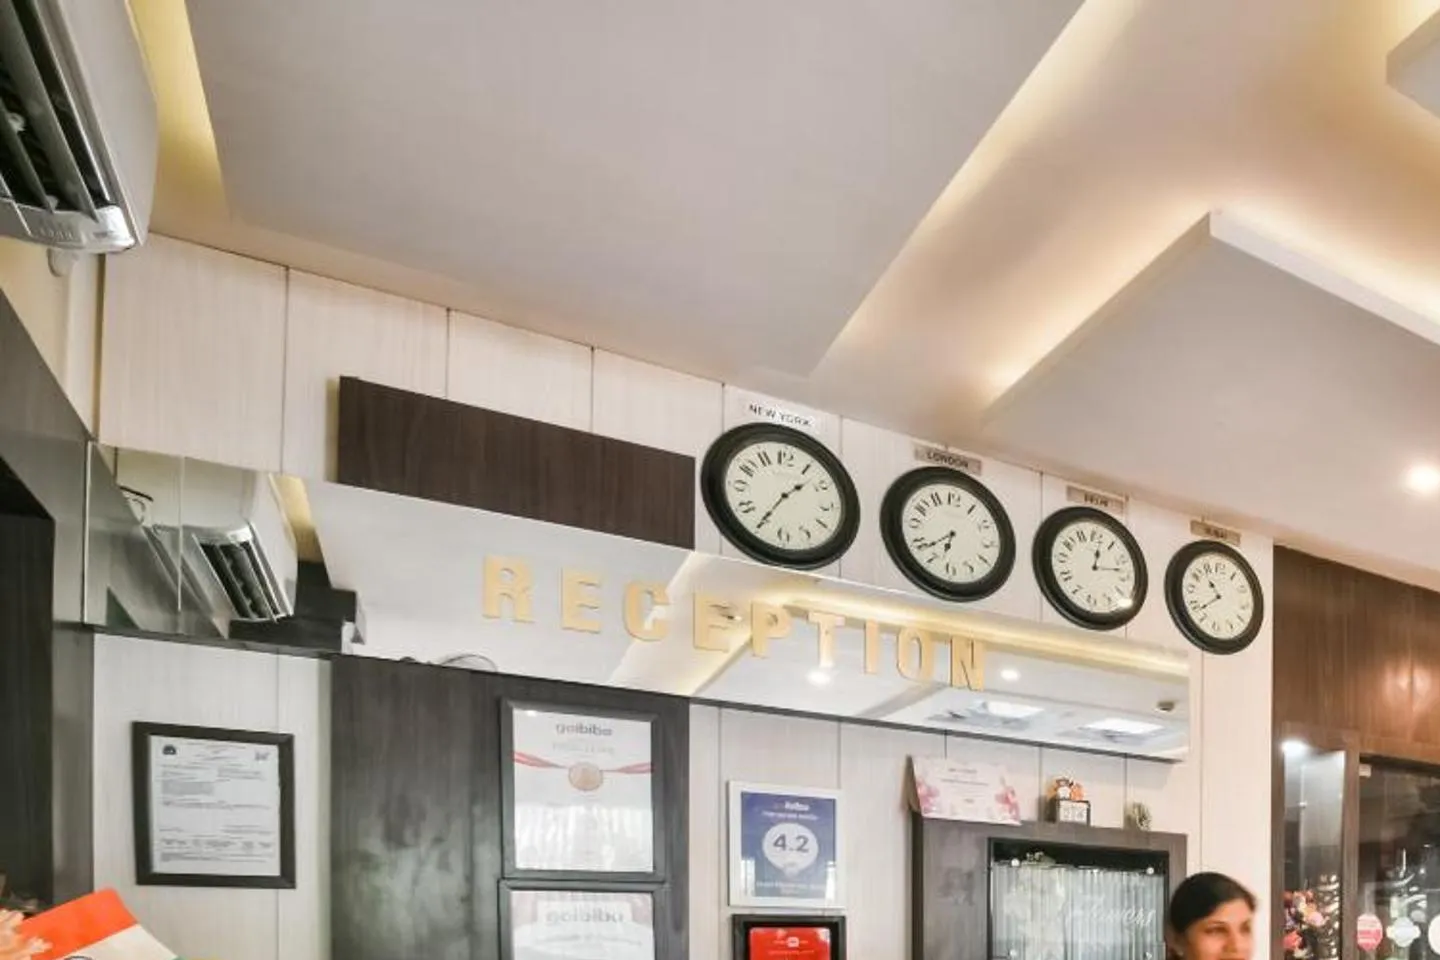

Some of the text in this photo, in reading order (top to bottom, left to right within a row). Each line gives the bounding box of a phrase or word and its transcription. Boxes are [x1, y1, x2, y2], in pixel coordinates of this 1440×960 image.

[749, 404, 812, 426] NEW YORK
[926, 451, 969, 468] LONDON
[481, 554, 986, 692] RECEPTION
[773, 833, 810, 853] 4.2
